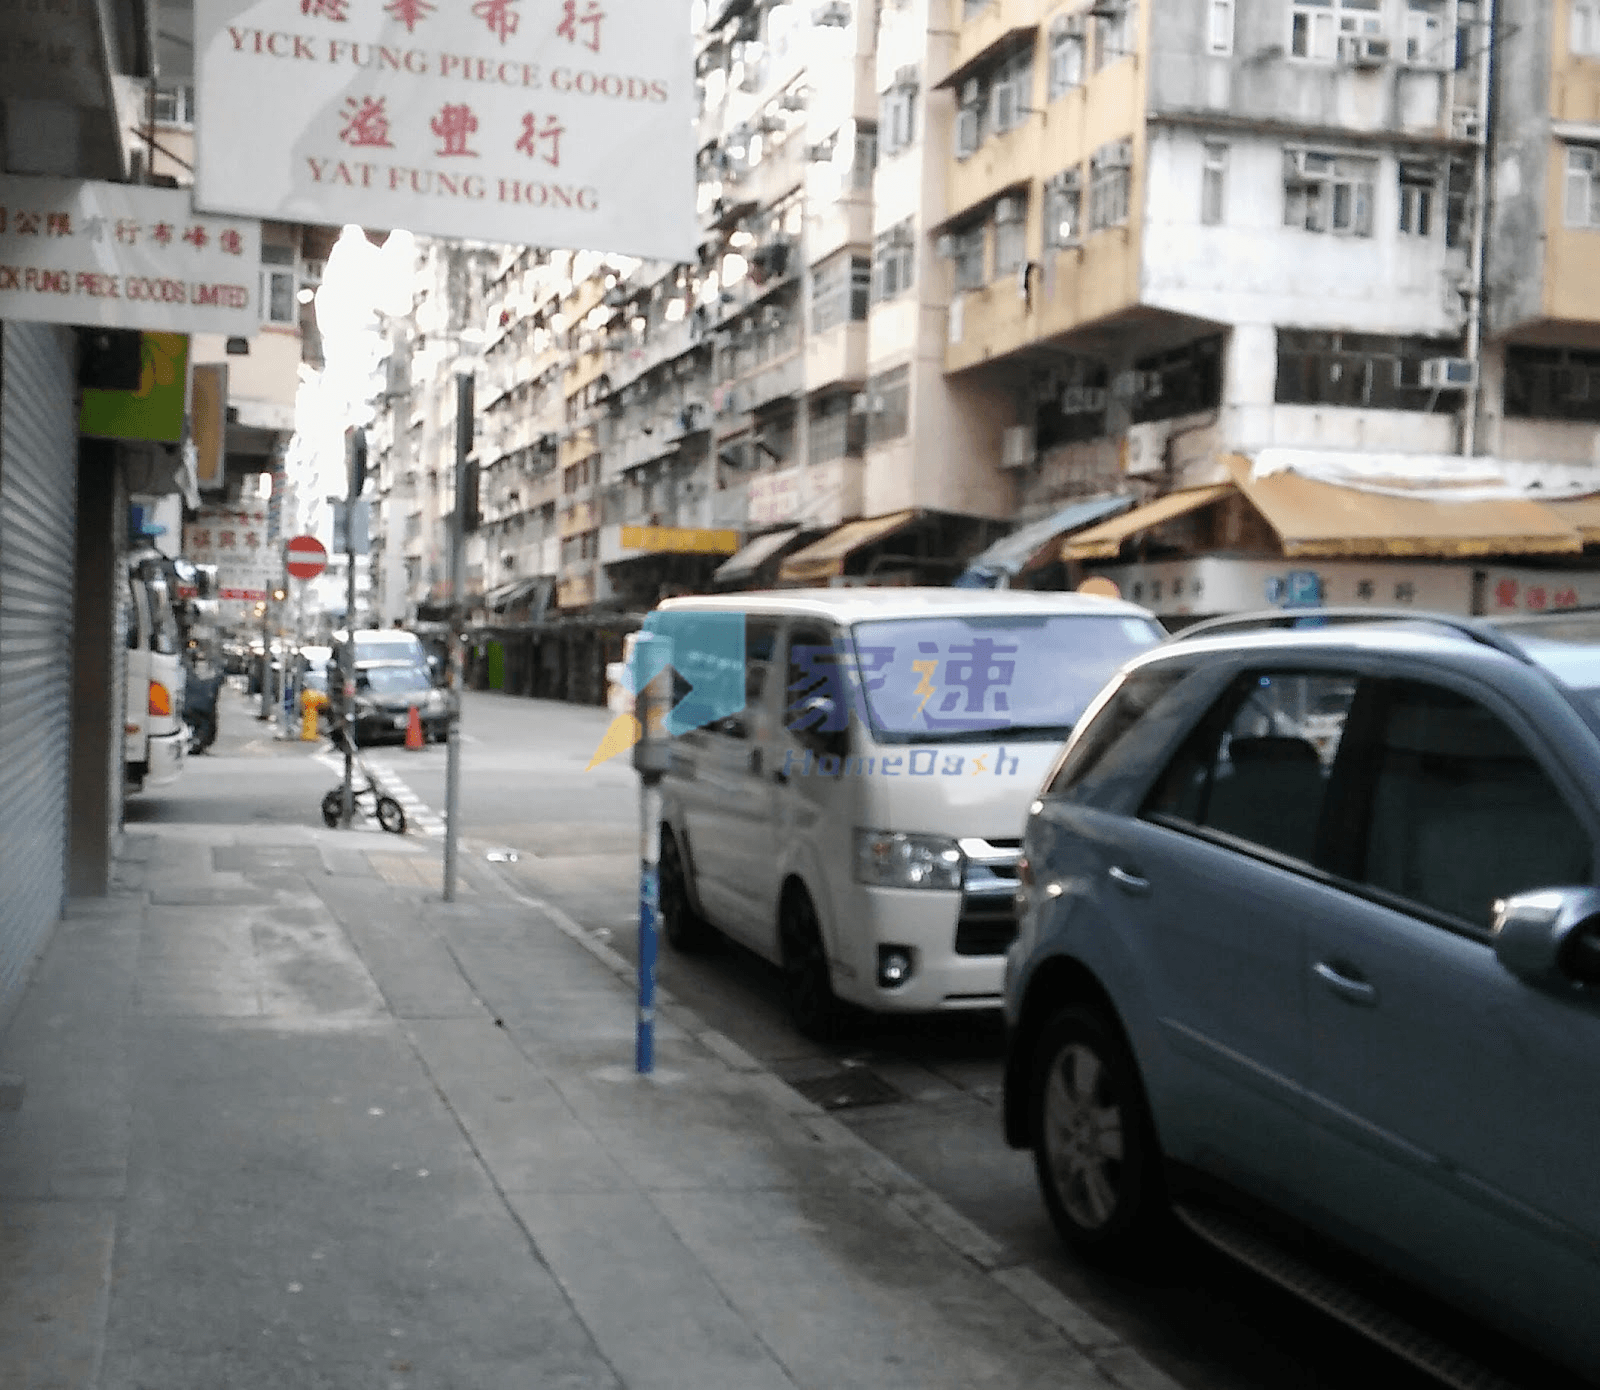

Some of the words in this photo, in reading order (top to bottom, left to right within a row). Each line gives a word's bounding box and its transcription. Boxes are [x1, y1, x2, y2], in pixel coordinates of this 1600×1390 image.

[228, 25, 317, 61] YICK
[327, 38, 429, 76] FUNG
[438, 54, 543, 90] PIECE
[550, 69, 669, 104] GOODS
[306, 156, 379, 191] YAT
[388, 166, 488, 201] FUNG
[496, 178, 600, 213] HONG
[25, 267, 71, 295] FUNG
[125, 276, 186, 304] GOODS
[190, 283, 249, 310] LIMITED
